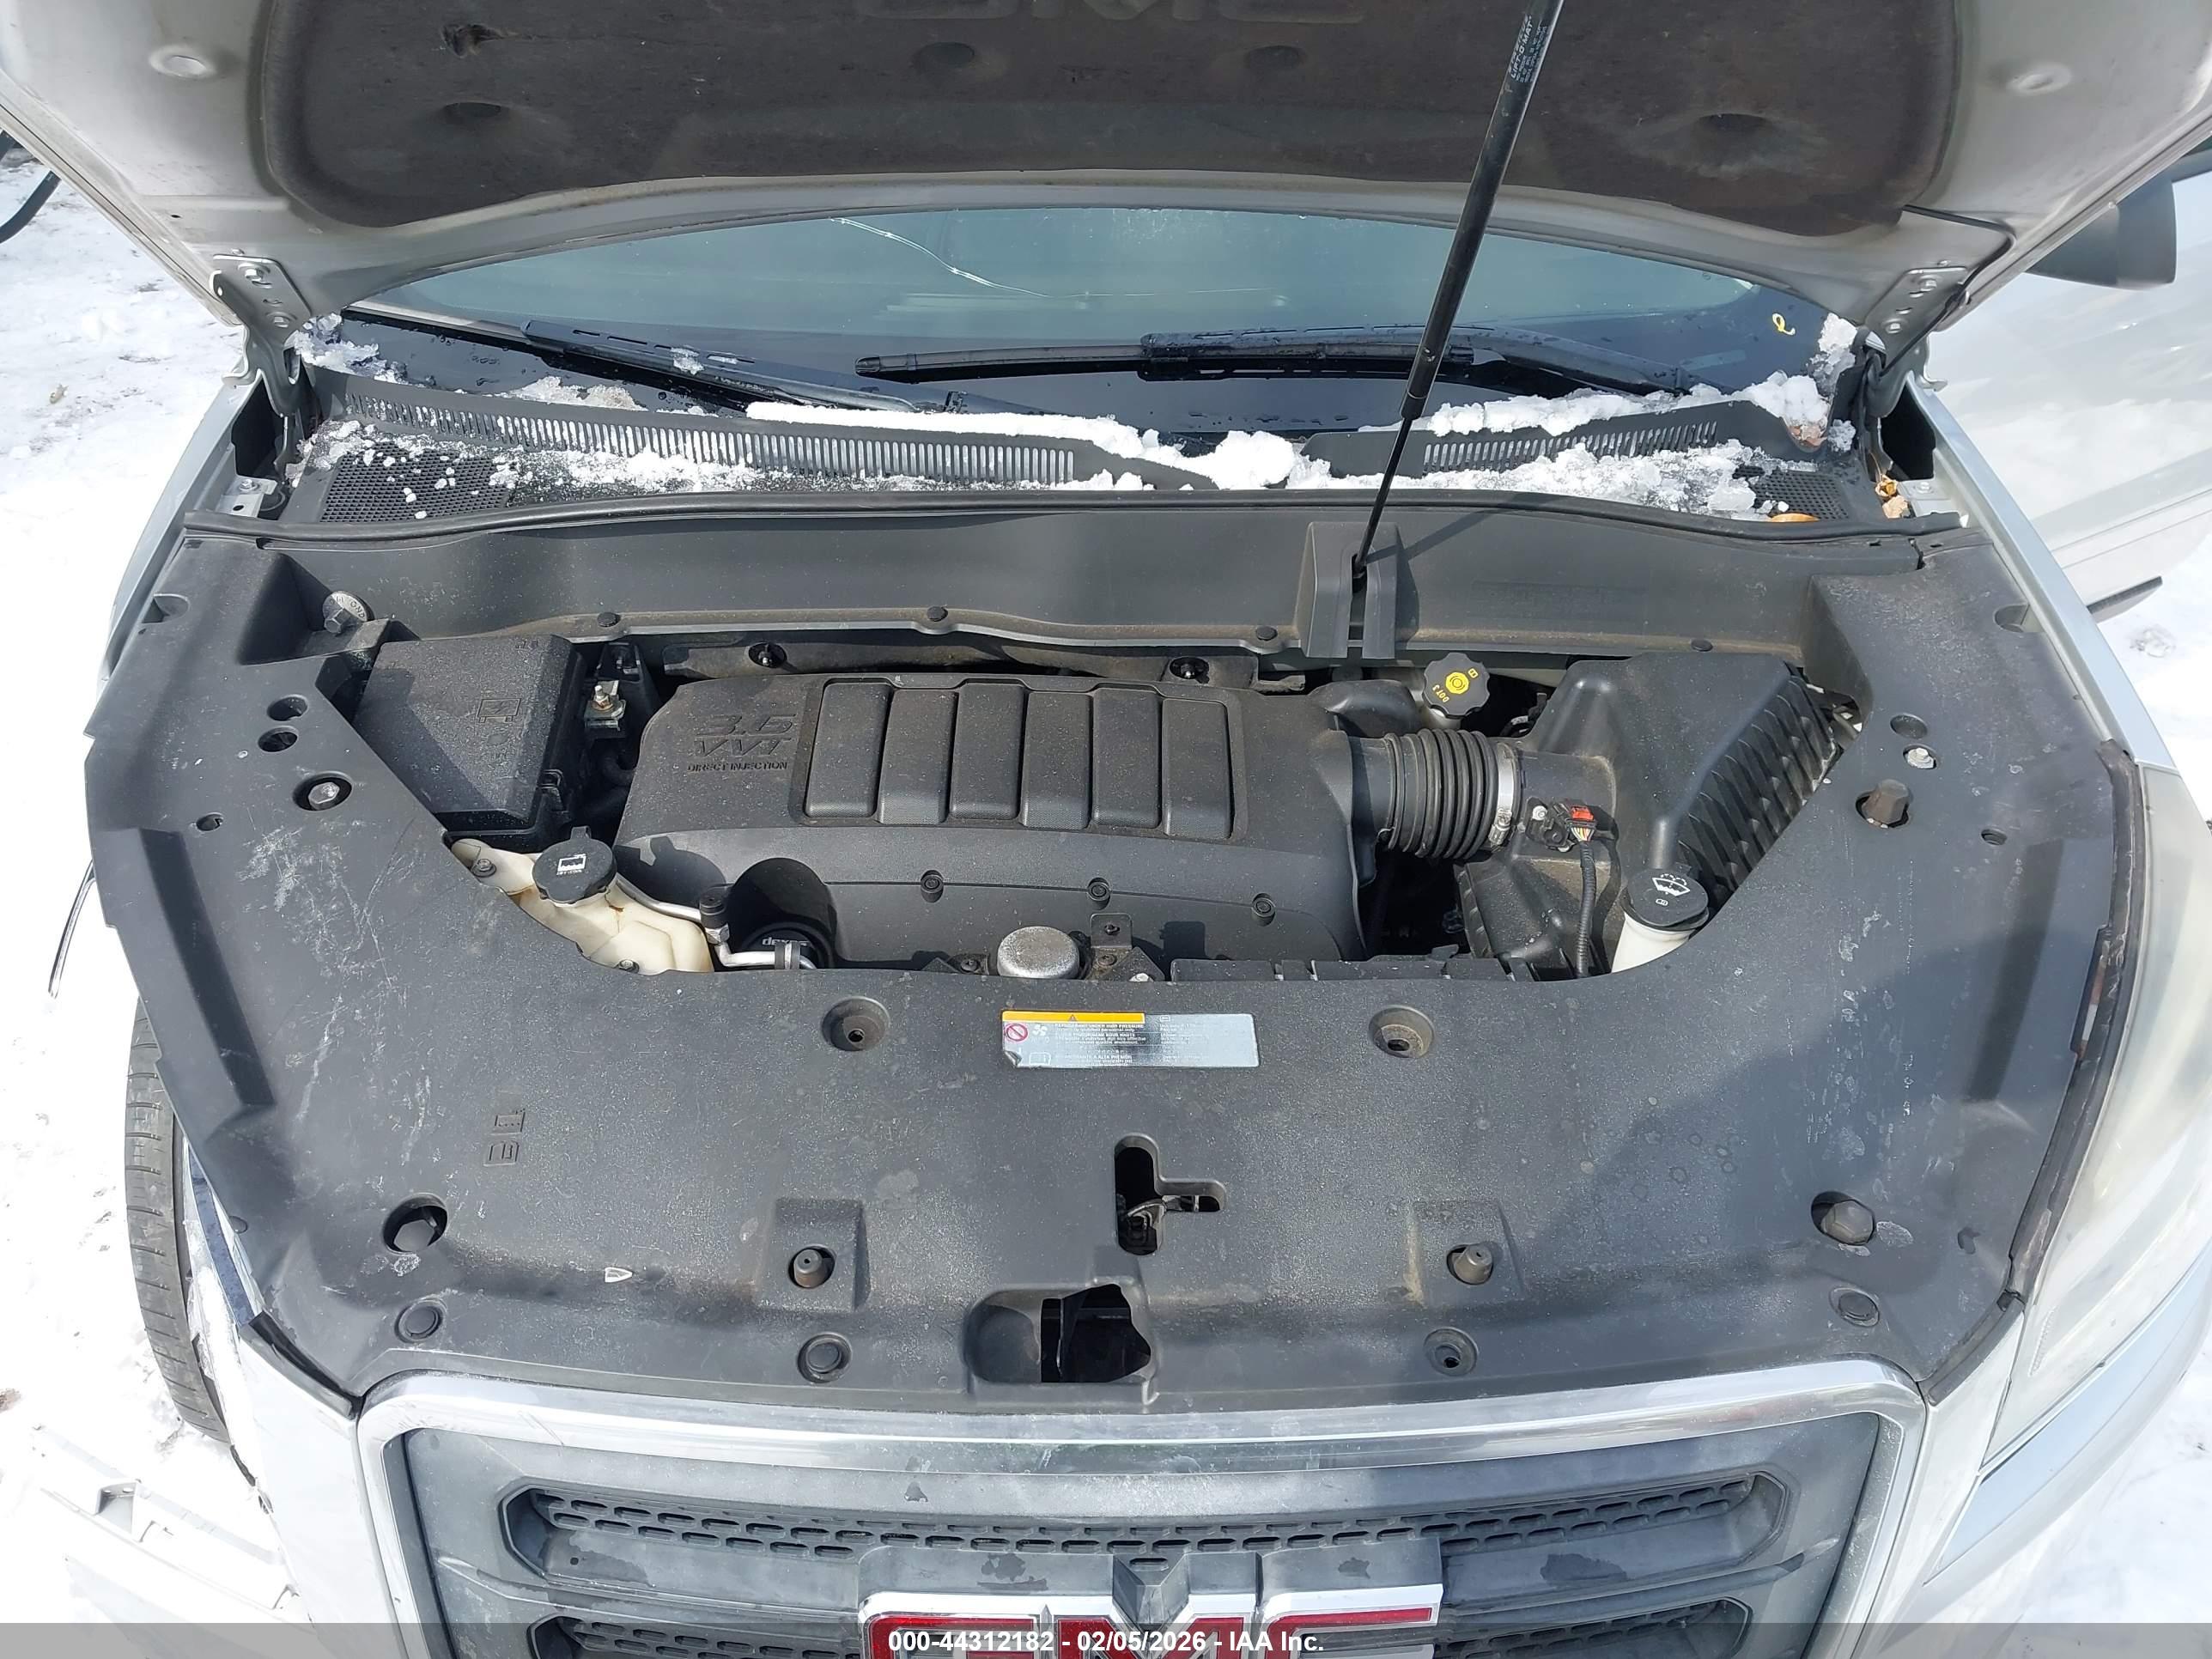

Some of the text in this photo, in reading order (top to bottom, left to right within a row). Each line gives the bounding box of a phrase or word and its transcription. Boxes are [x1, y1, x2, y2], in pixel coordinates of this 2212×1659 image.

[693, 738, 792, 756] VVT
[688, 762, 788, 772] DIRECT INJECTION
